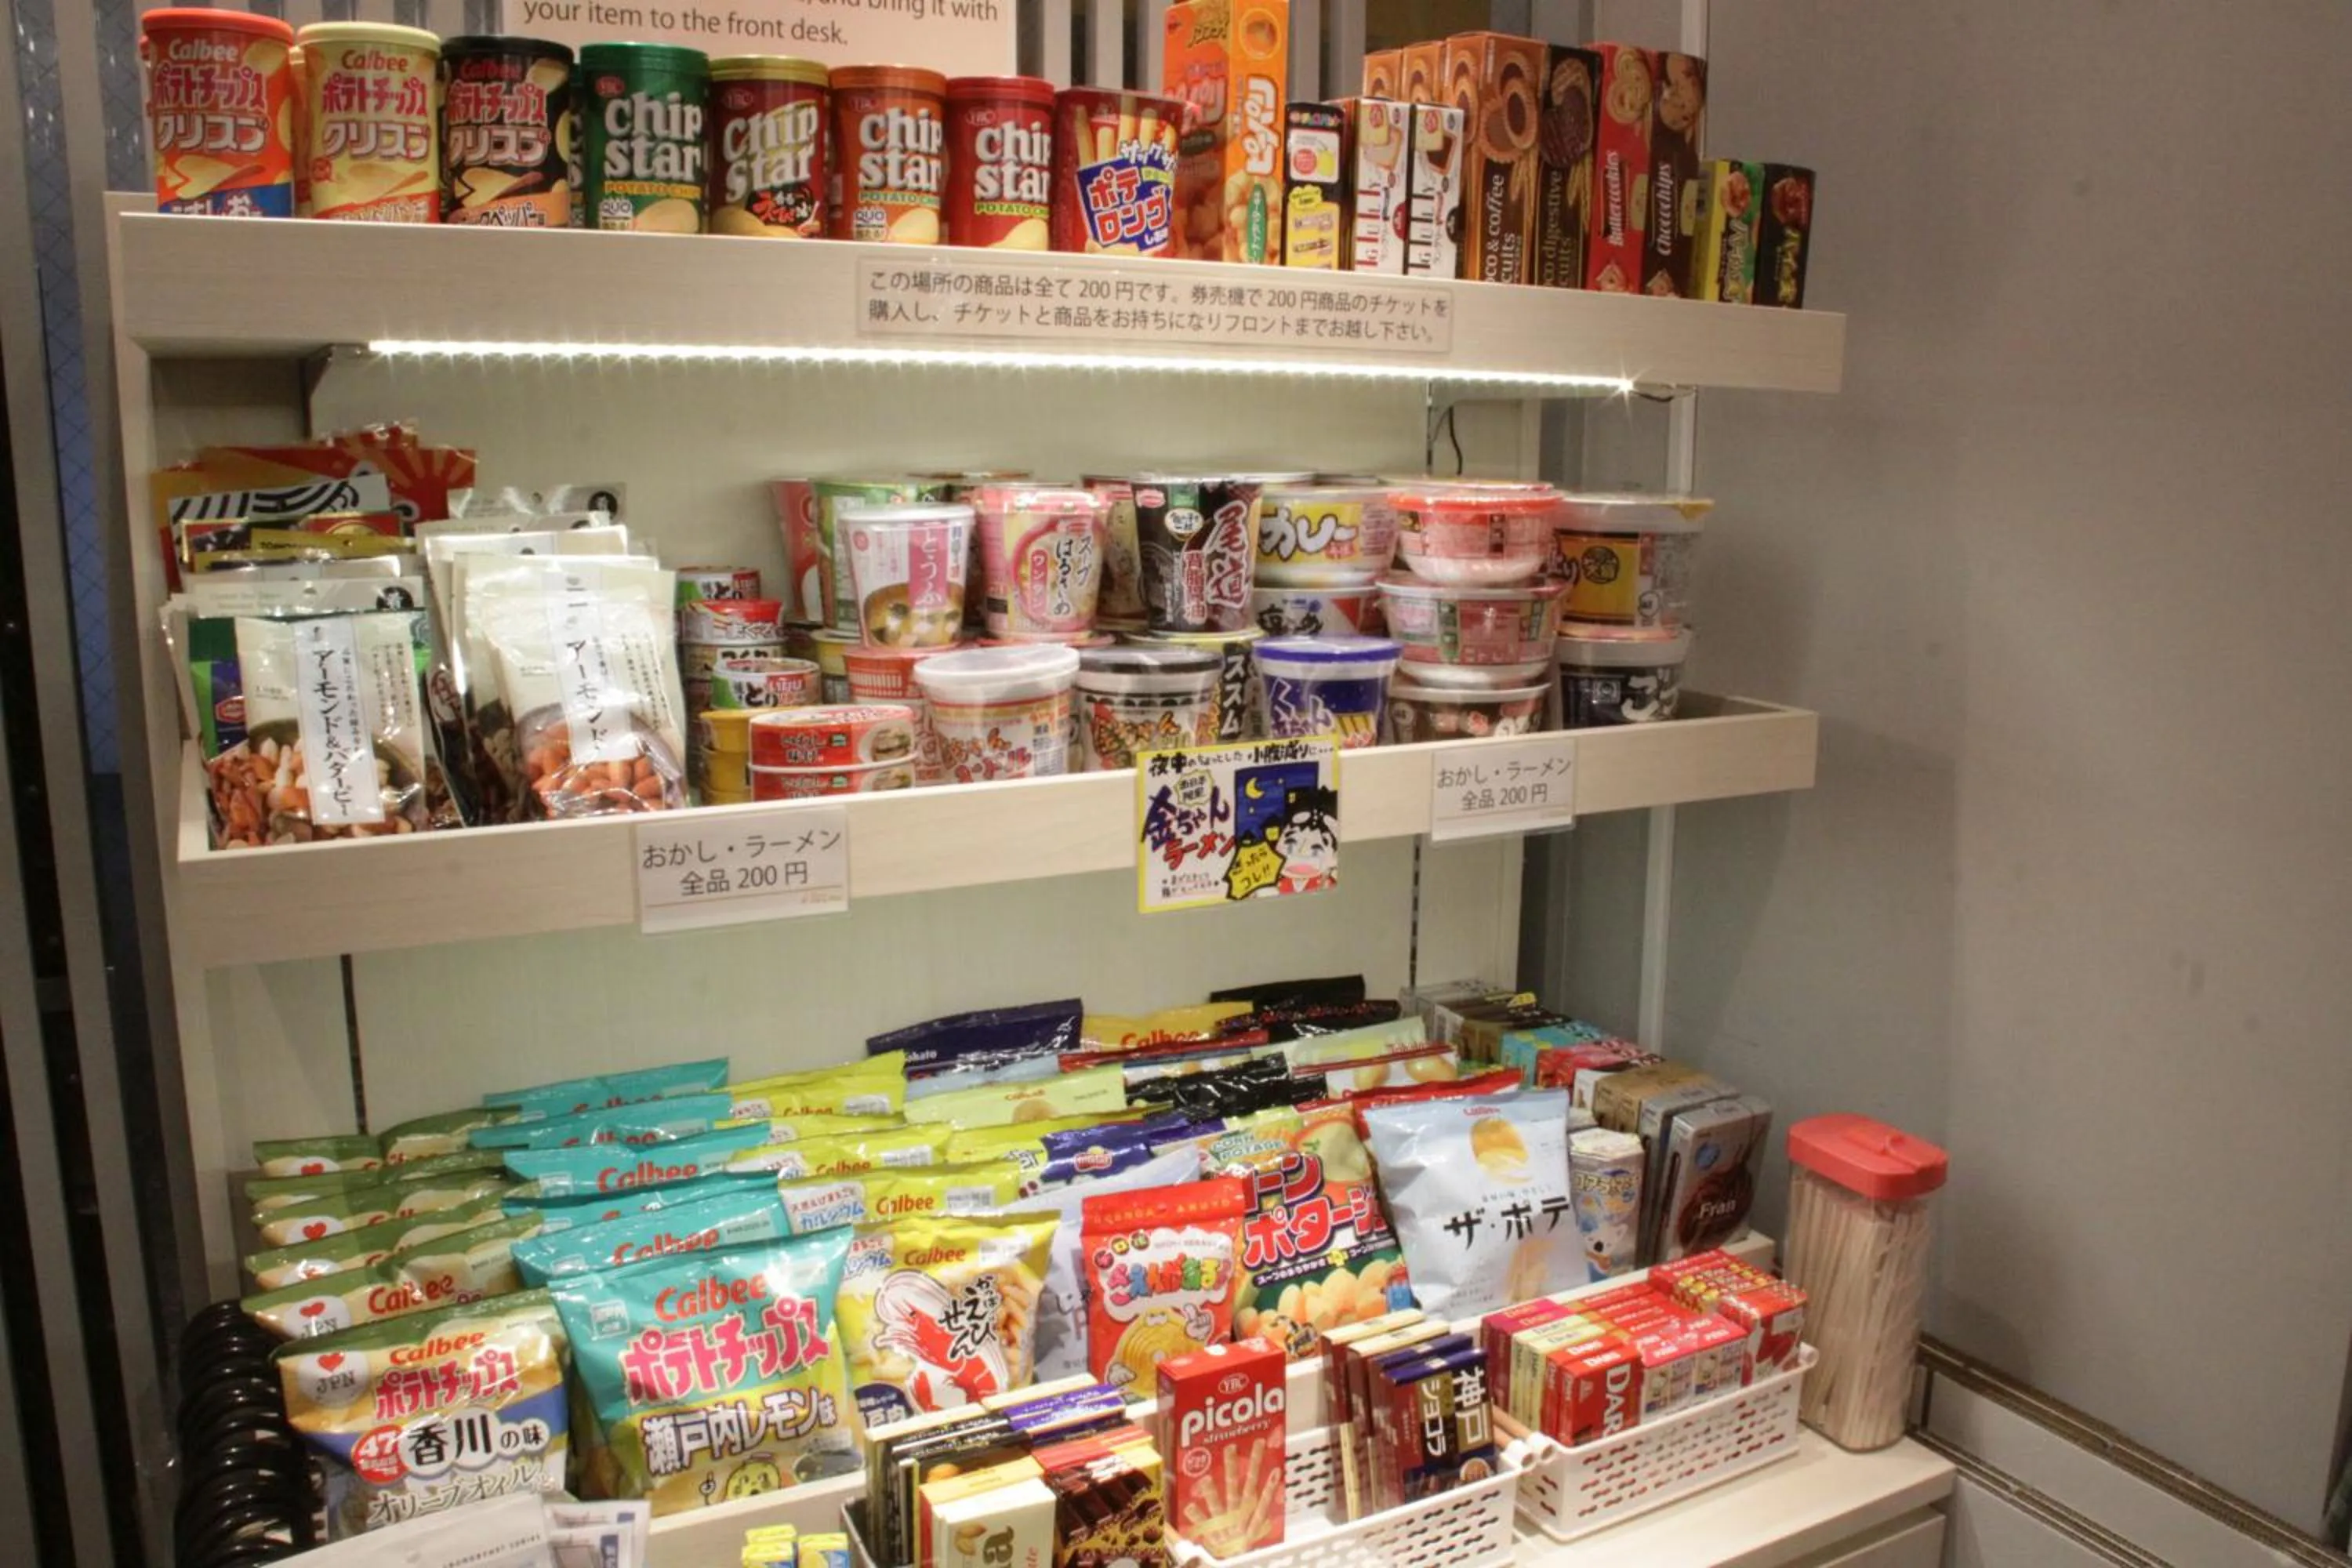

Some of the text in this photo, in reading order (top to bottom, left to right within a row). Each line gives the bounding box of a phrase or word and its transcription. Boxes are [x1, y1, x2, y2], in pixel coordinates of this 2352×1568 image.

[522, 2, 849, 45] your item to the front desk.
[862, 0, 924, 20] bring
[953, 2, 999, 22] with
[169, 38, 238, 61] Calbee
[341, 49, 408, 72] Calbee
[154, 63, 267, 112] ポテトチップス
[322, 74, 427, 117] ポテトチップス
[448, 81, 548, 124] ポテトチップス
[157, 111, 269, 152] クリスプ
[604, 92, 702, 142] chip
[858, 107, 942, 154] chip
[322, 122, 431, 161] クリスプ
[448, 125, 550, 166] クリスプ
[604, 138, 702, 181] star
[973, 122, 1051, 164] chip
[858, 152, 942, 192] star
[973, 162, 1051, 203] star
[1087, 166, 1141, 211] ポテ
[600, 201, 632, 216] QUO
[854, 209, 886, 222] QUO
[1094, 186, 1168, 245] ロング
[1486, 174, 1504, 236] coffee
[1541, 169, 1563, 259] digestive
[1054, 539, 1074, 617] はるさめ
[1076, 534, 1095, 587] スープ
[565, 638, 609, 751] アーモンド
[1437, 758, 1572, 789] おかし・ラーメン
[643, 831, 841, 869] おかし・ラーメン
[1163, 831, 1236, 871] ラーメン
[875, 1195, 935, 1215] Calbee
[1699, 1197, 1737, 1219] Fran
[903, 1247, 967, 1266] Calbee
[655, 1272, 767, 1323] Calbee
[389, 1331, 486, 1367] Calbee
[620, 1296, 830, 1404] ポテトチップス
[316, 1370, 356, 1395] JPN
[375, 1349, 521, 1421] ポテトチップス
[1218, 1372, 1250, 1395] YBC
[1180, 1382, 1286, 1448] picola
[1421, 1378, 1448, 1458] ショコラ
[1451, 1365, 1489, 1445] 神戸
[359, 1431, 400, 1458] 47
[641, 1386, 838, 1475] 瀬戸内レモン味
